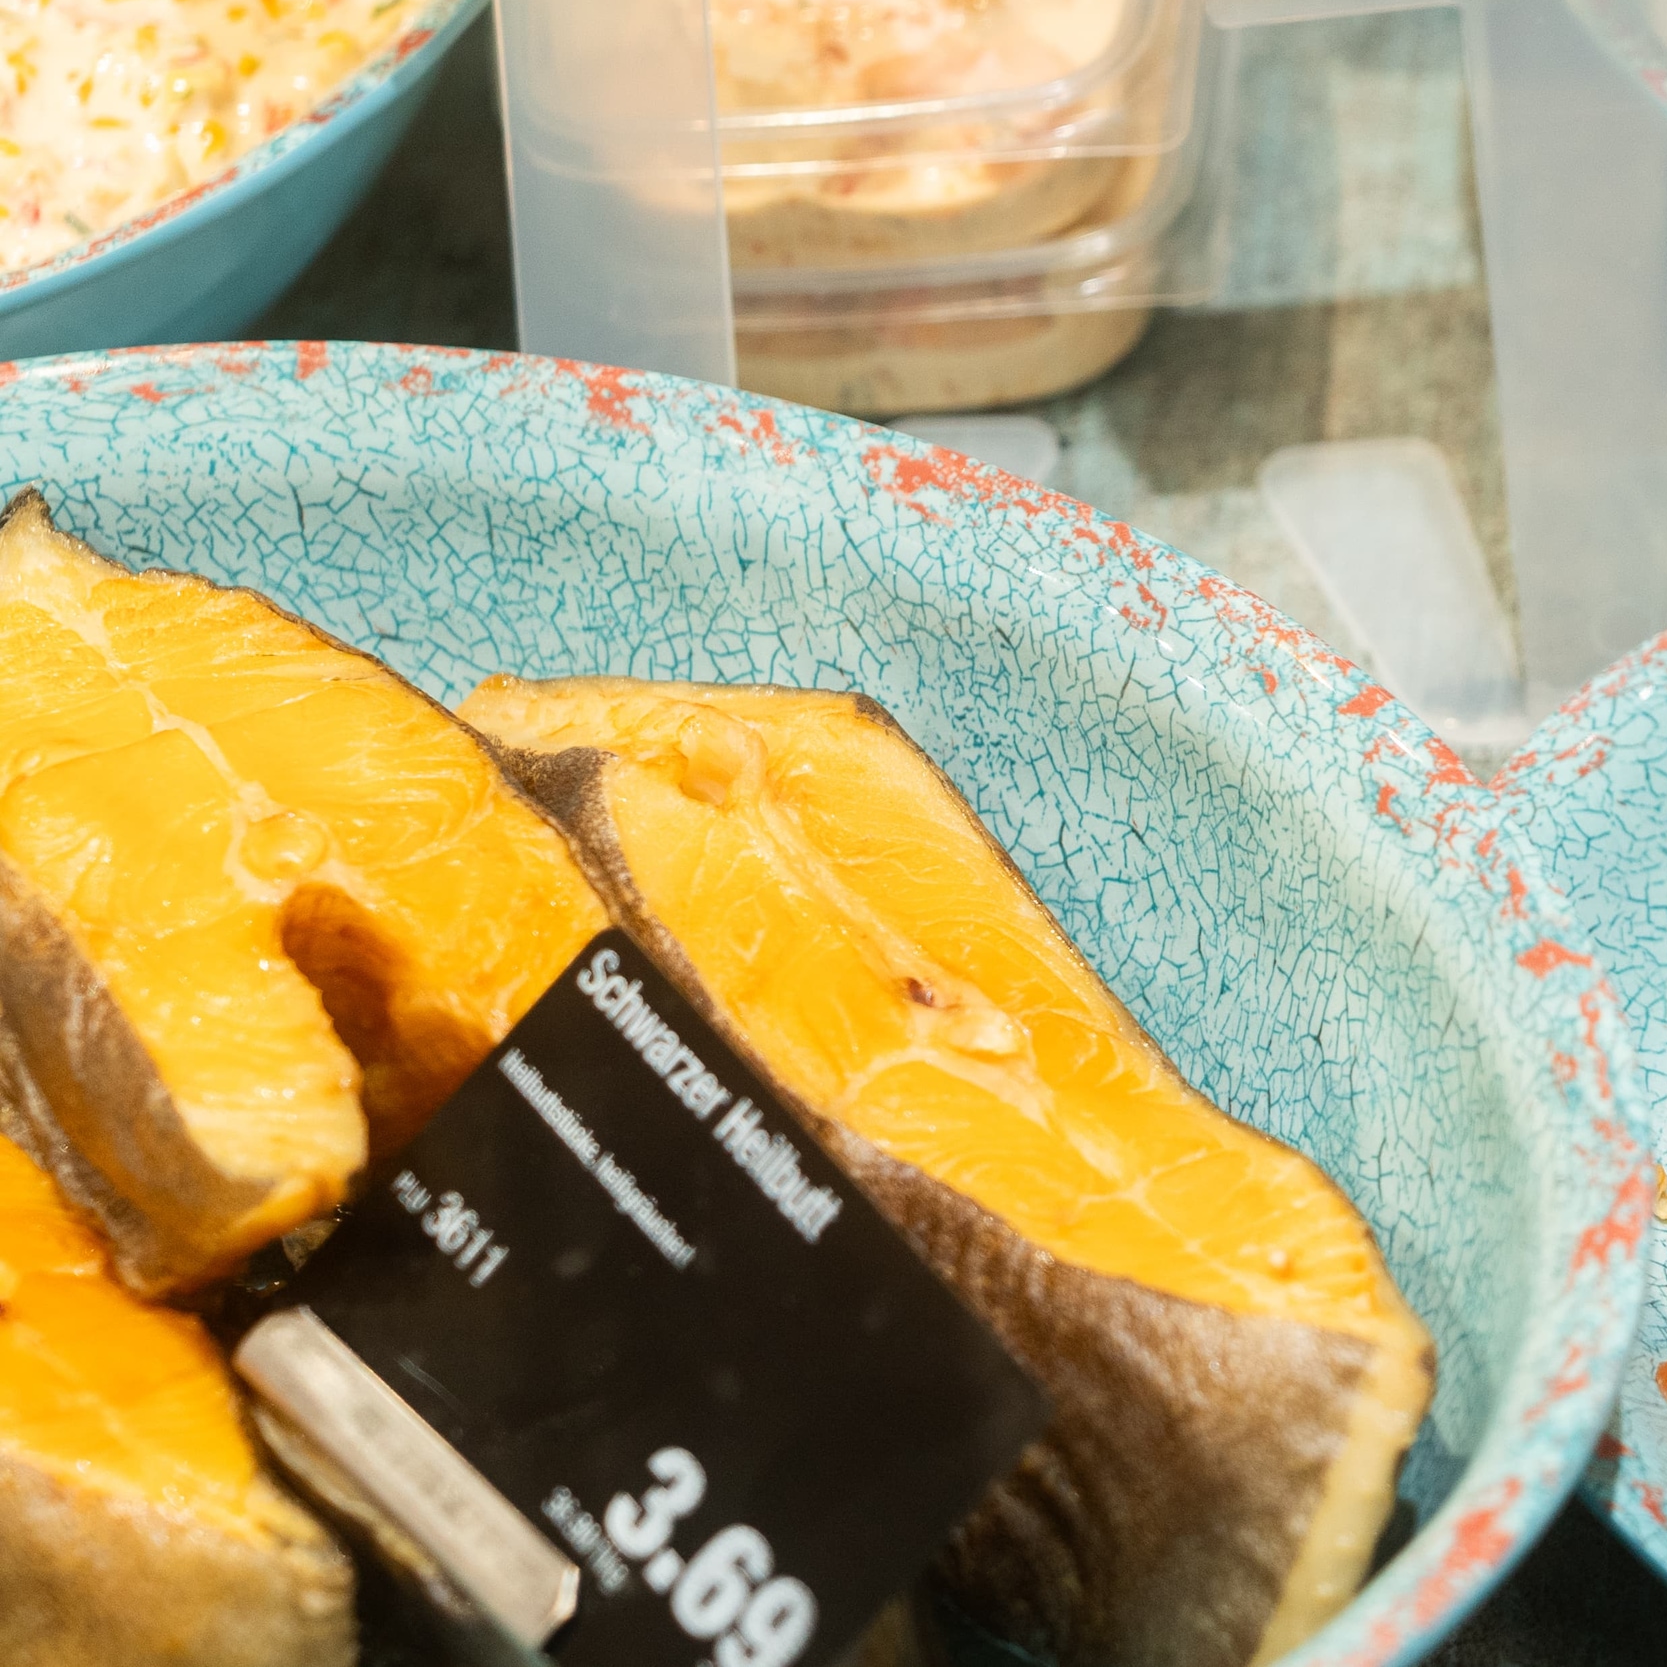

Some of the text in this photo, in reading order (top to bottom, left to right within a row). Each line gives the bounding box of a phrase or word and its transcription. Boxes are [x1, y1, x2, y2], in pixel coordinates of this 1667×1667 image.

[499, 1049, 600, 1170] Heilbuttstücke,
[576, 948, 843, 1241] Schwarzer Heilbutt
[393, 1171, 509, 1285] PLU 3611
[603, 1446, 818, 1667] 3.69
